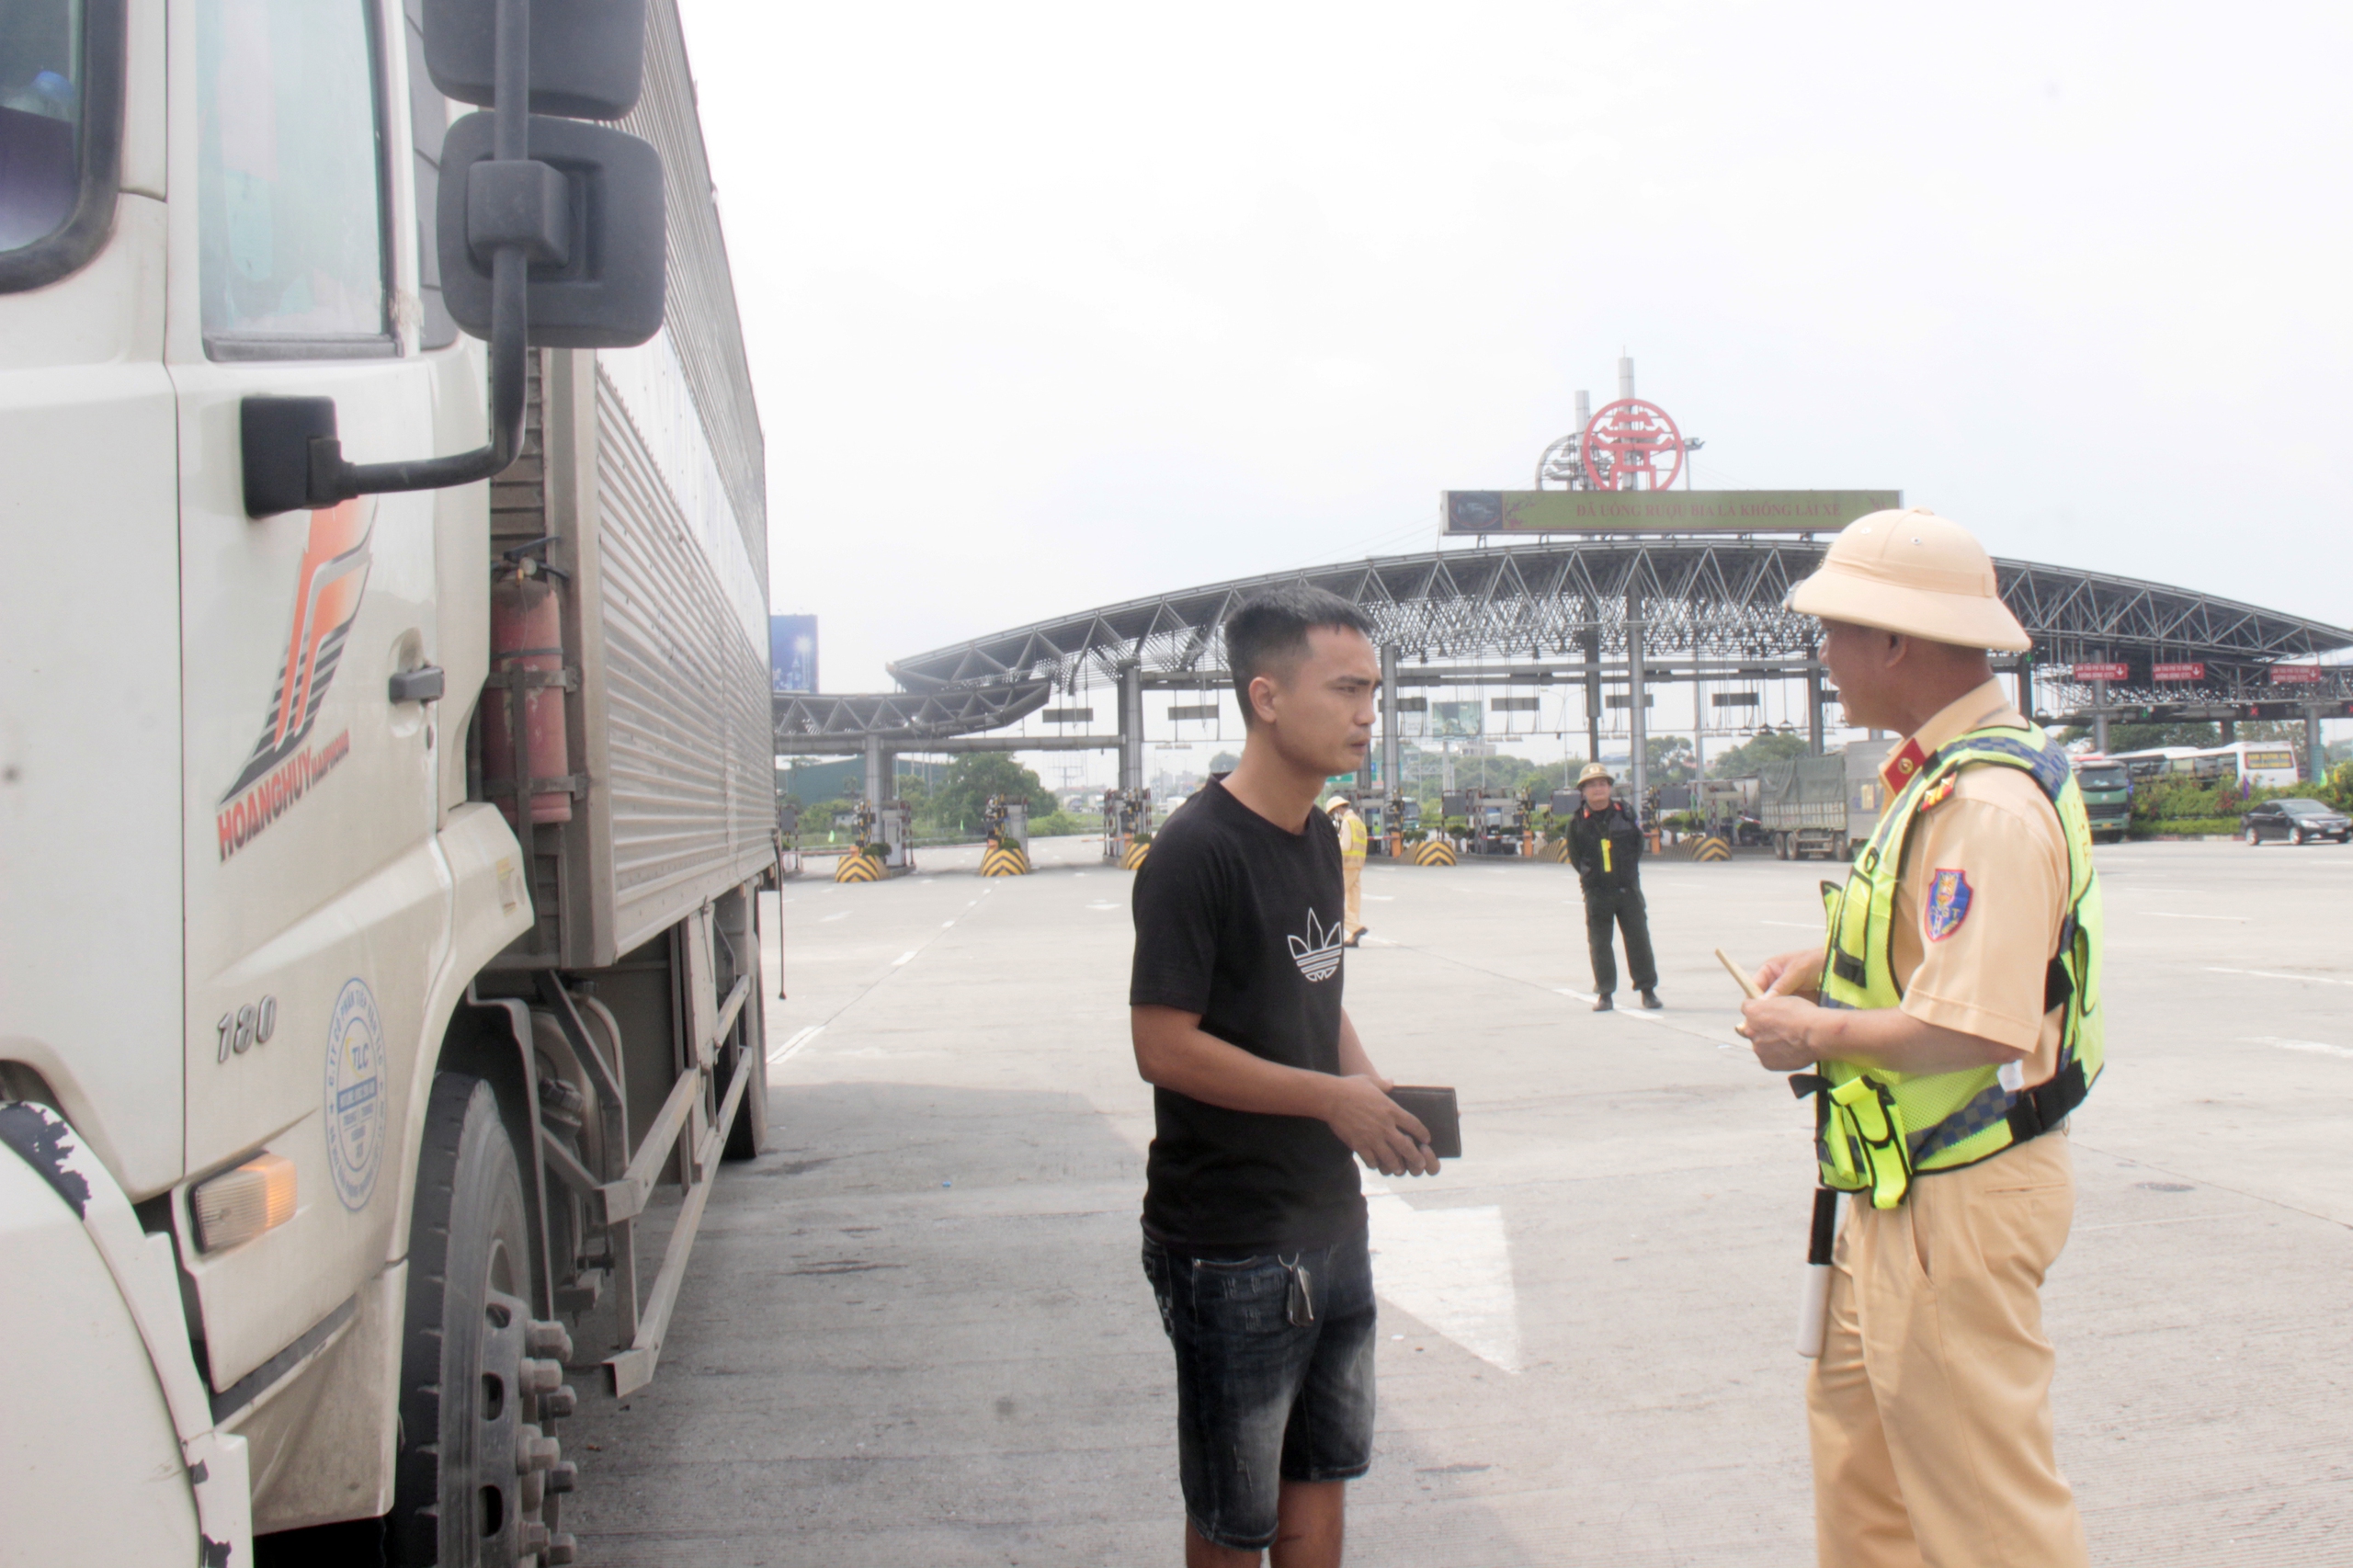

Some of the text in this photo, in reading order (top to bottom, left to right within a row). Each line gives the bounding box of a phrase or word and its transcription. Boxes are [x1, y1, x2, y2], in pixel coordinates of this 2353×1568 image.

[1576, 502, 1597, 517] ĐÃ
[1600, 502, 1641, 517] UỐNG
[1691, 505, 1714, 517] BIA
[1741, 502, 1792, 517] KHÔNG
[1824, 504, 1841, 517] XE
[217, 746, 312, 863] HOANGHUY
[218, 994, 278, 1063] 180
[351, 1041, 369, 1071] TLC
